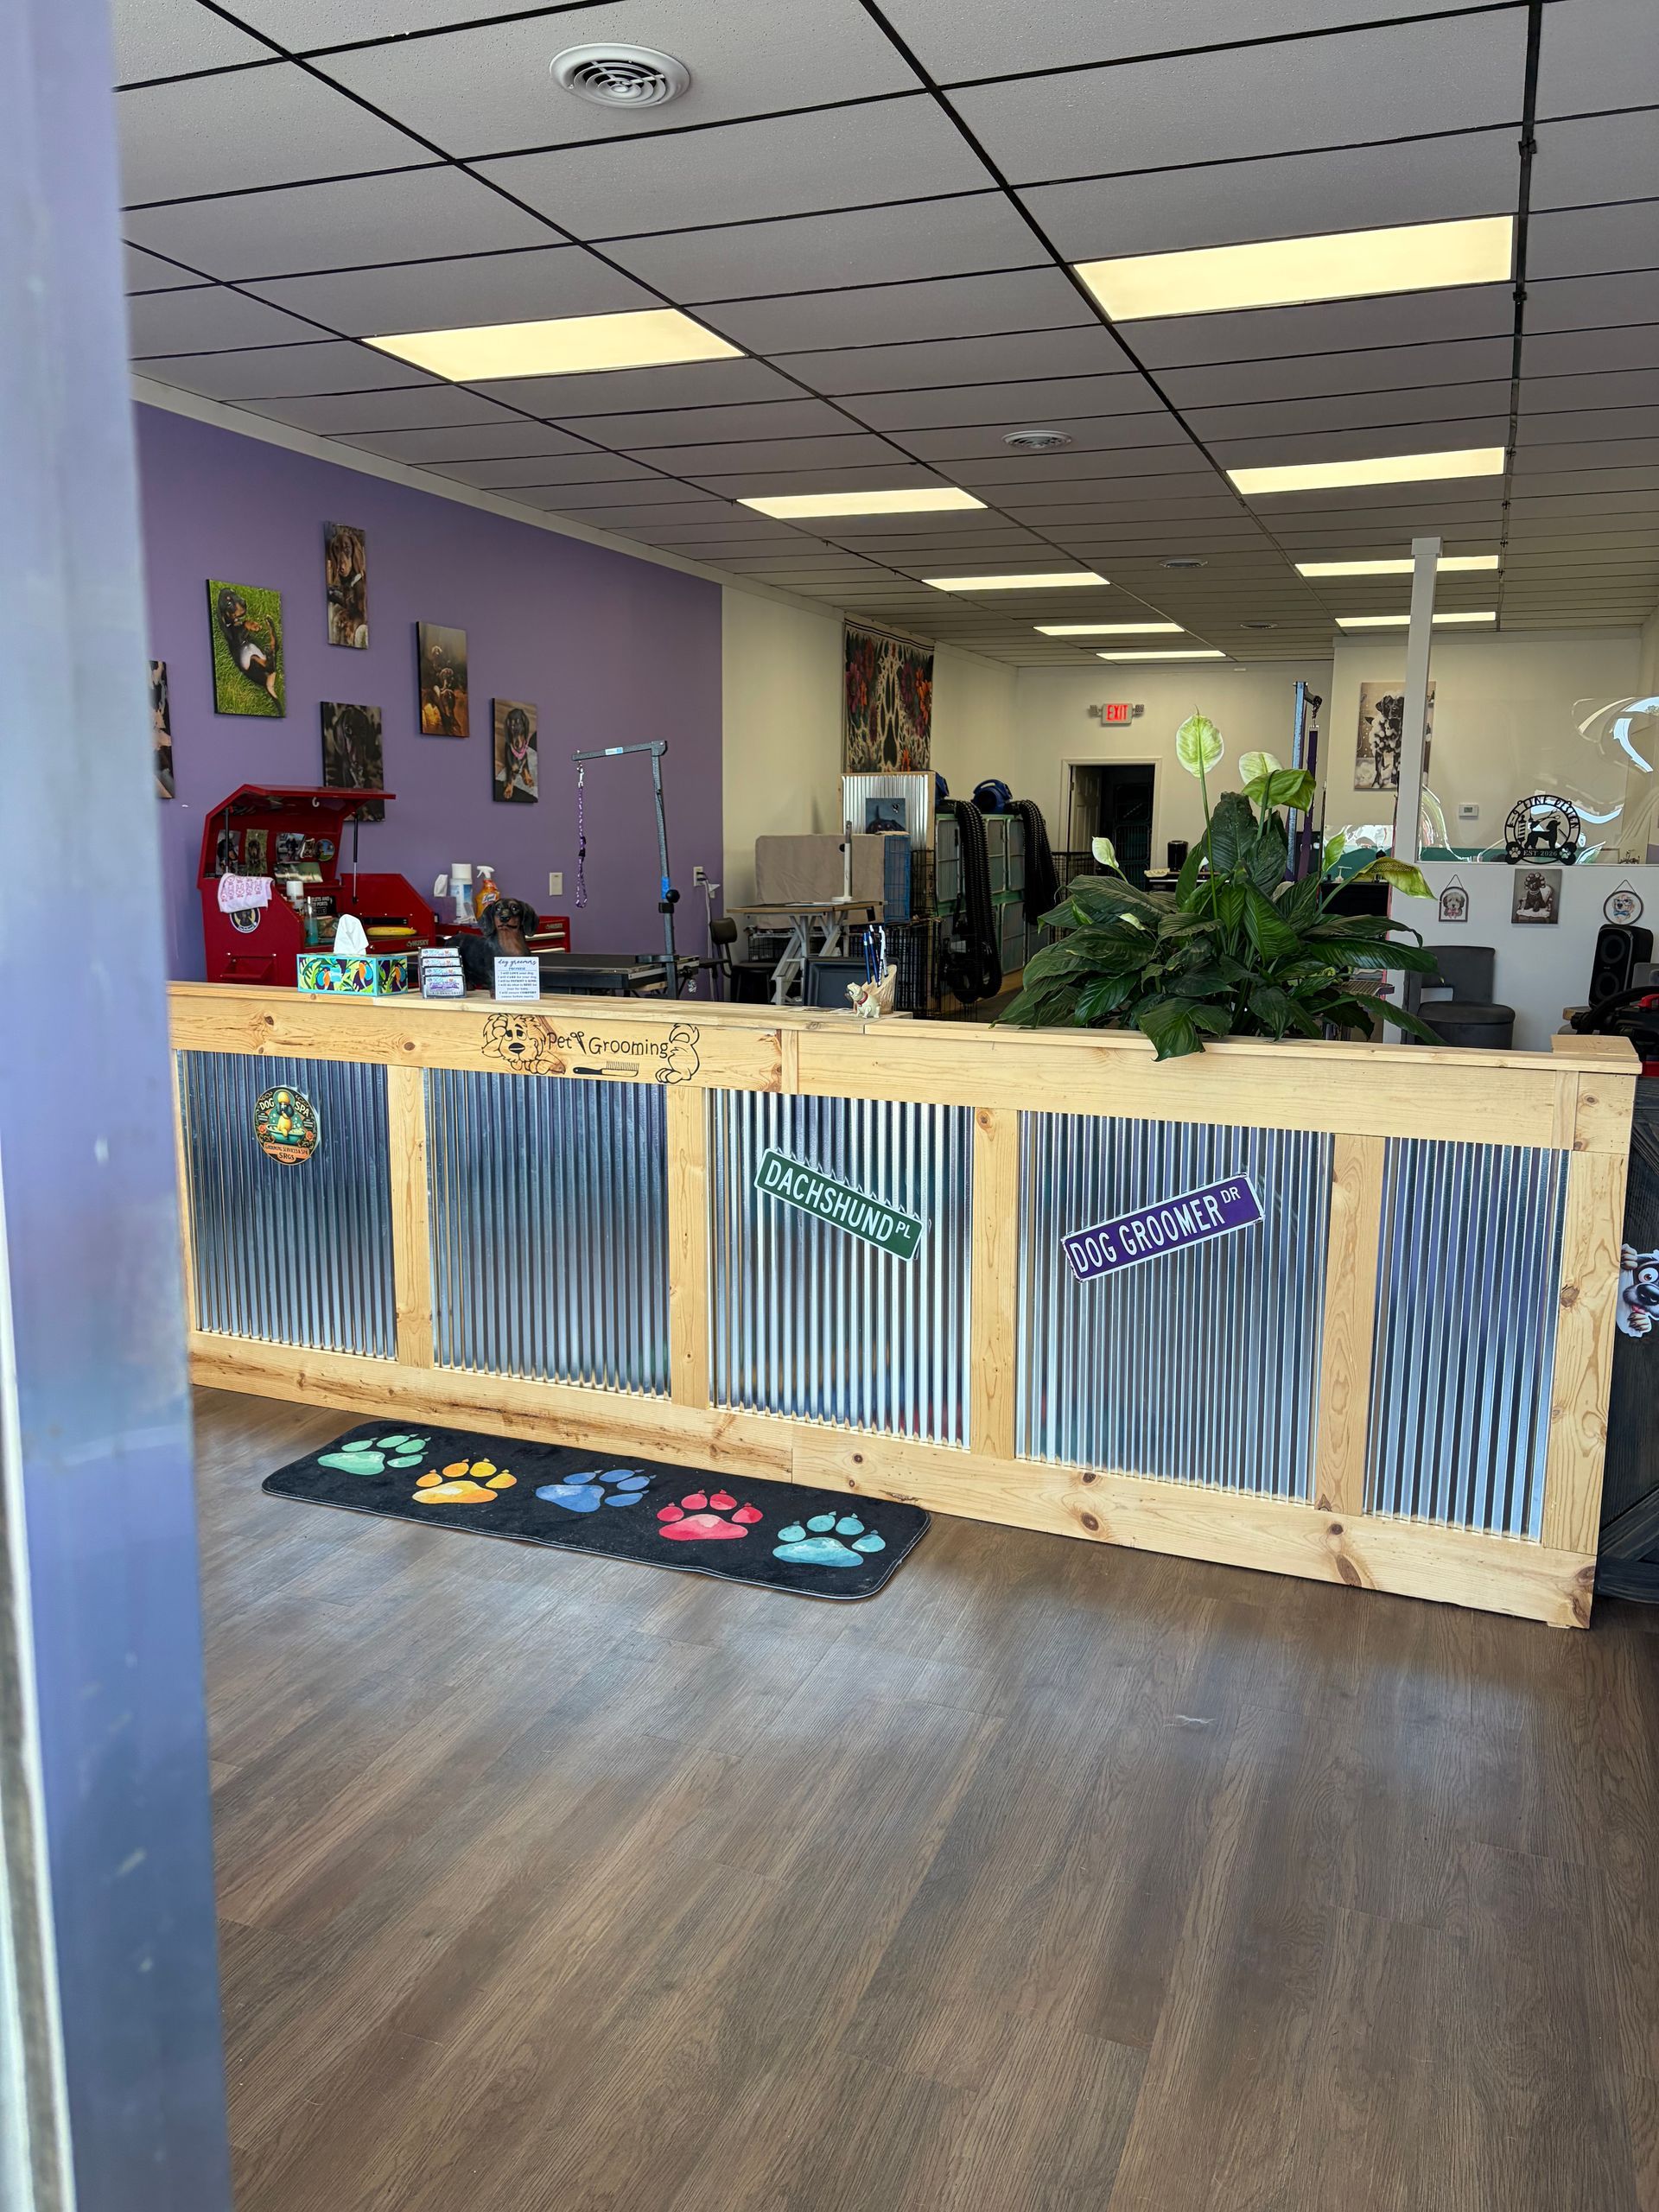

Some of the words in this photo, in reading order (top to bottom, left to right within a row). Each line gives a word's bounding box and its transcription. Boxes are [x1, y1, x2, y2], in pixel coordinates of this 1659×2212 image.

[1107, 704, 1128, 720] EXIT
[546, 1032, 573, 1050] Pet
[588, 1036, 669, 1059] Grooming
[259, 1097, 275, 1110] DOG
[295, 1101, 309, 1117] SPA
[764, 1159, 894, 1243] DACHSHUND
[895, 1220, 912, 1240] PL
[1069, 1231, 1117, 1274] DOG
[1118, 1195, 1225, 1256] GROOMER
[1220, 1186, 1242, 1205] DR
